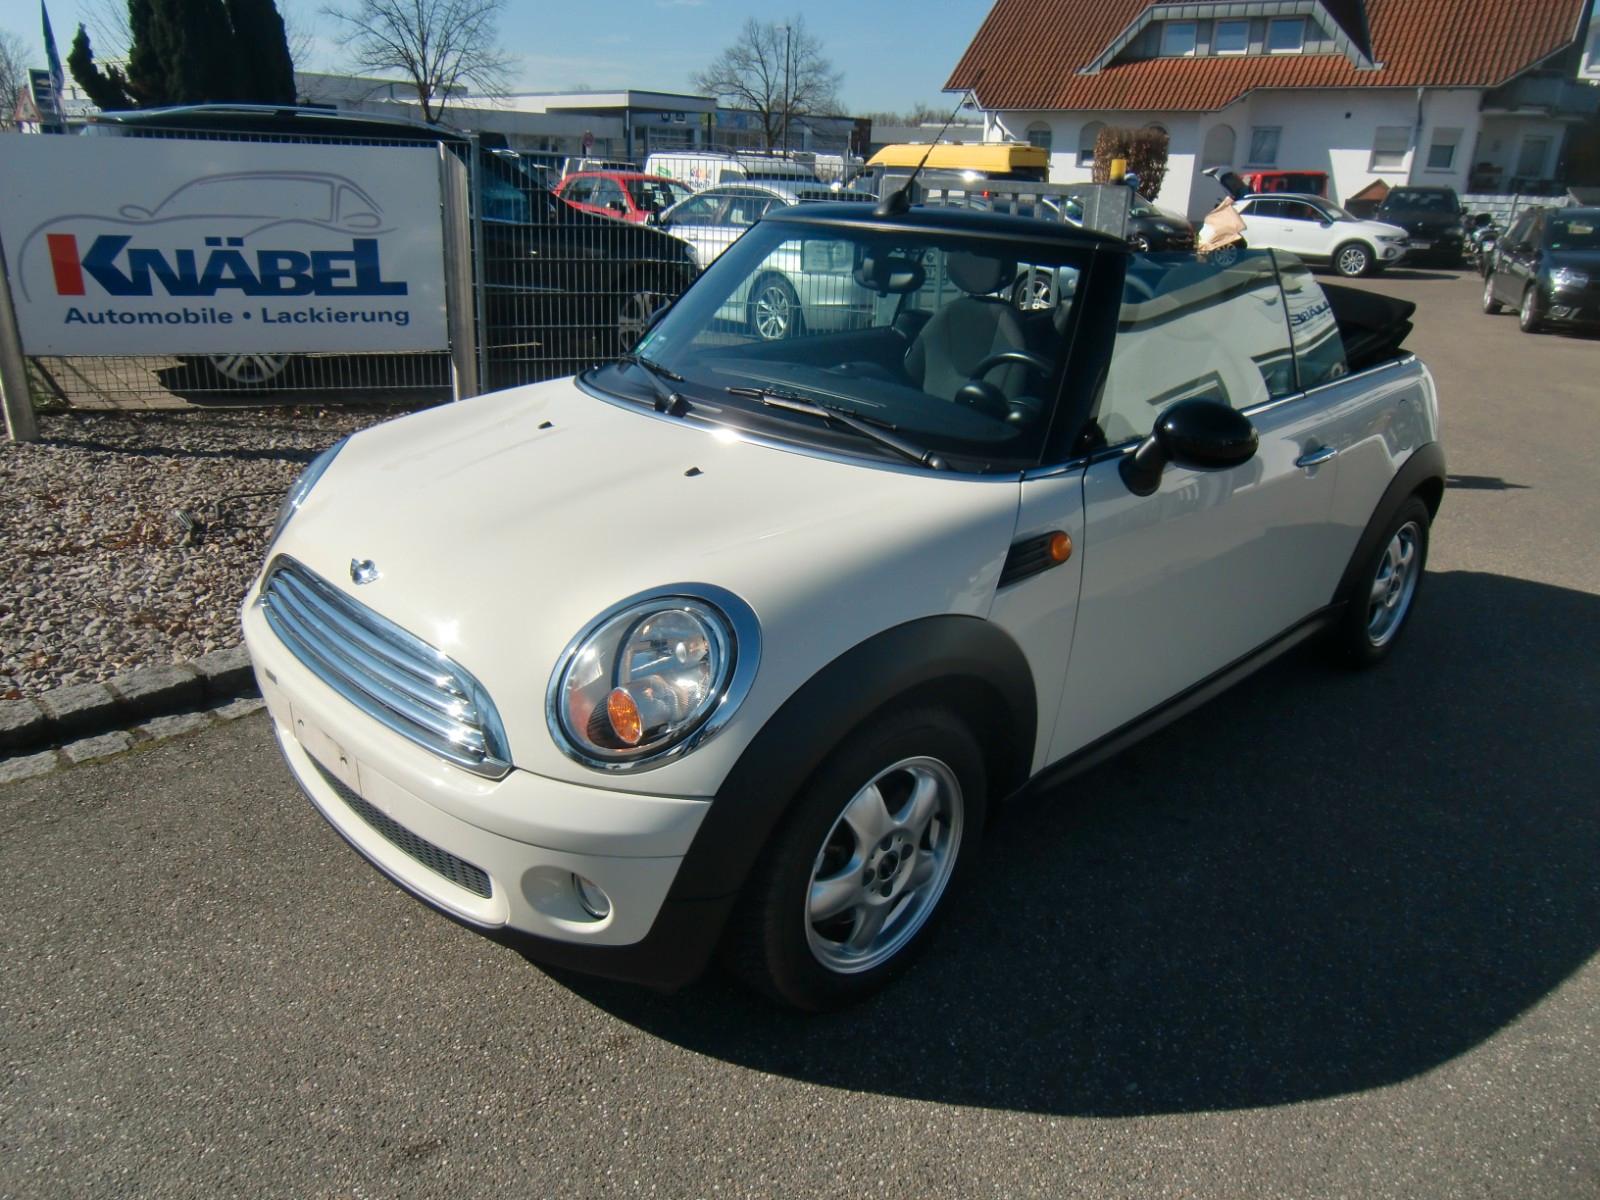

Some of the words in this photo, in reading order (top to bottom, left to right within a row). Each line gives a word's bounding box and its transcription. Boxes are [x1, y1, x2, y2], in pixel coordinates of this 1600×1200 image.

[46, 233, 408, 297] KNÄBEL
[64, 307, 233, 325] Automobile
[262, 307, 410, 326] Lackierung
